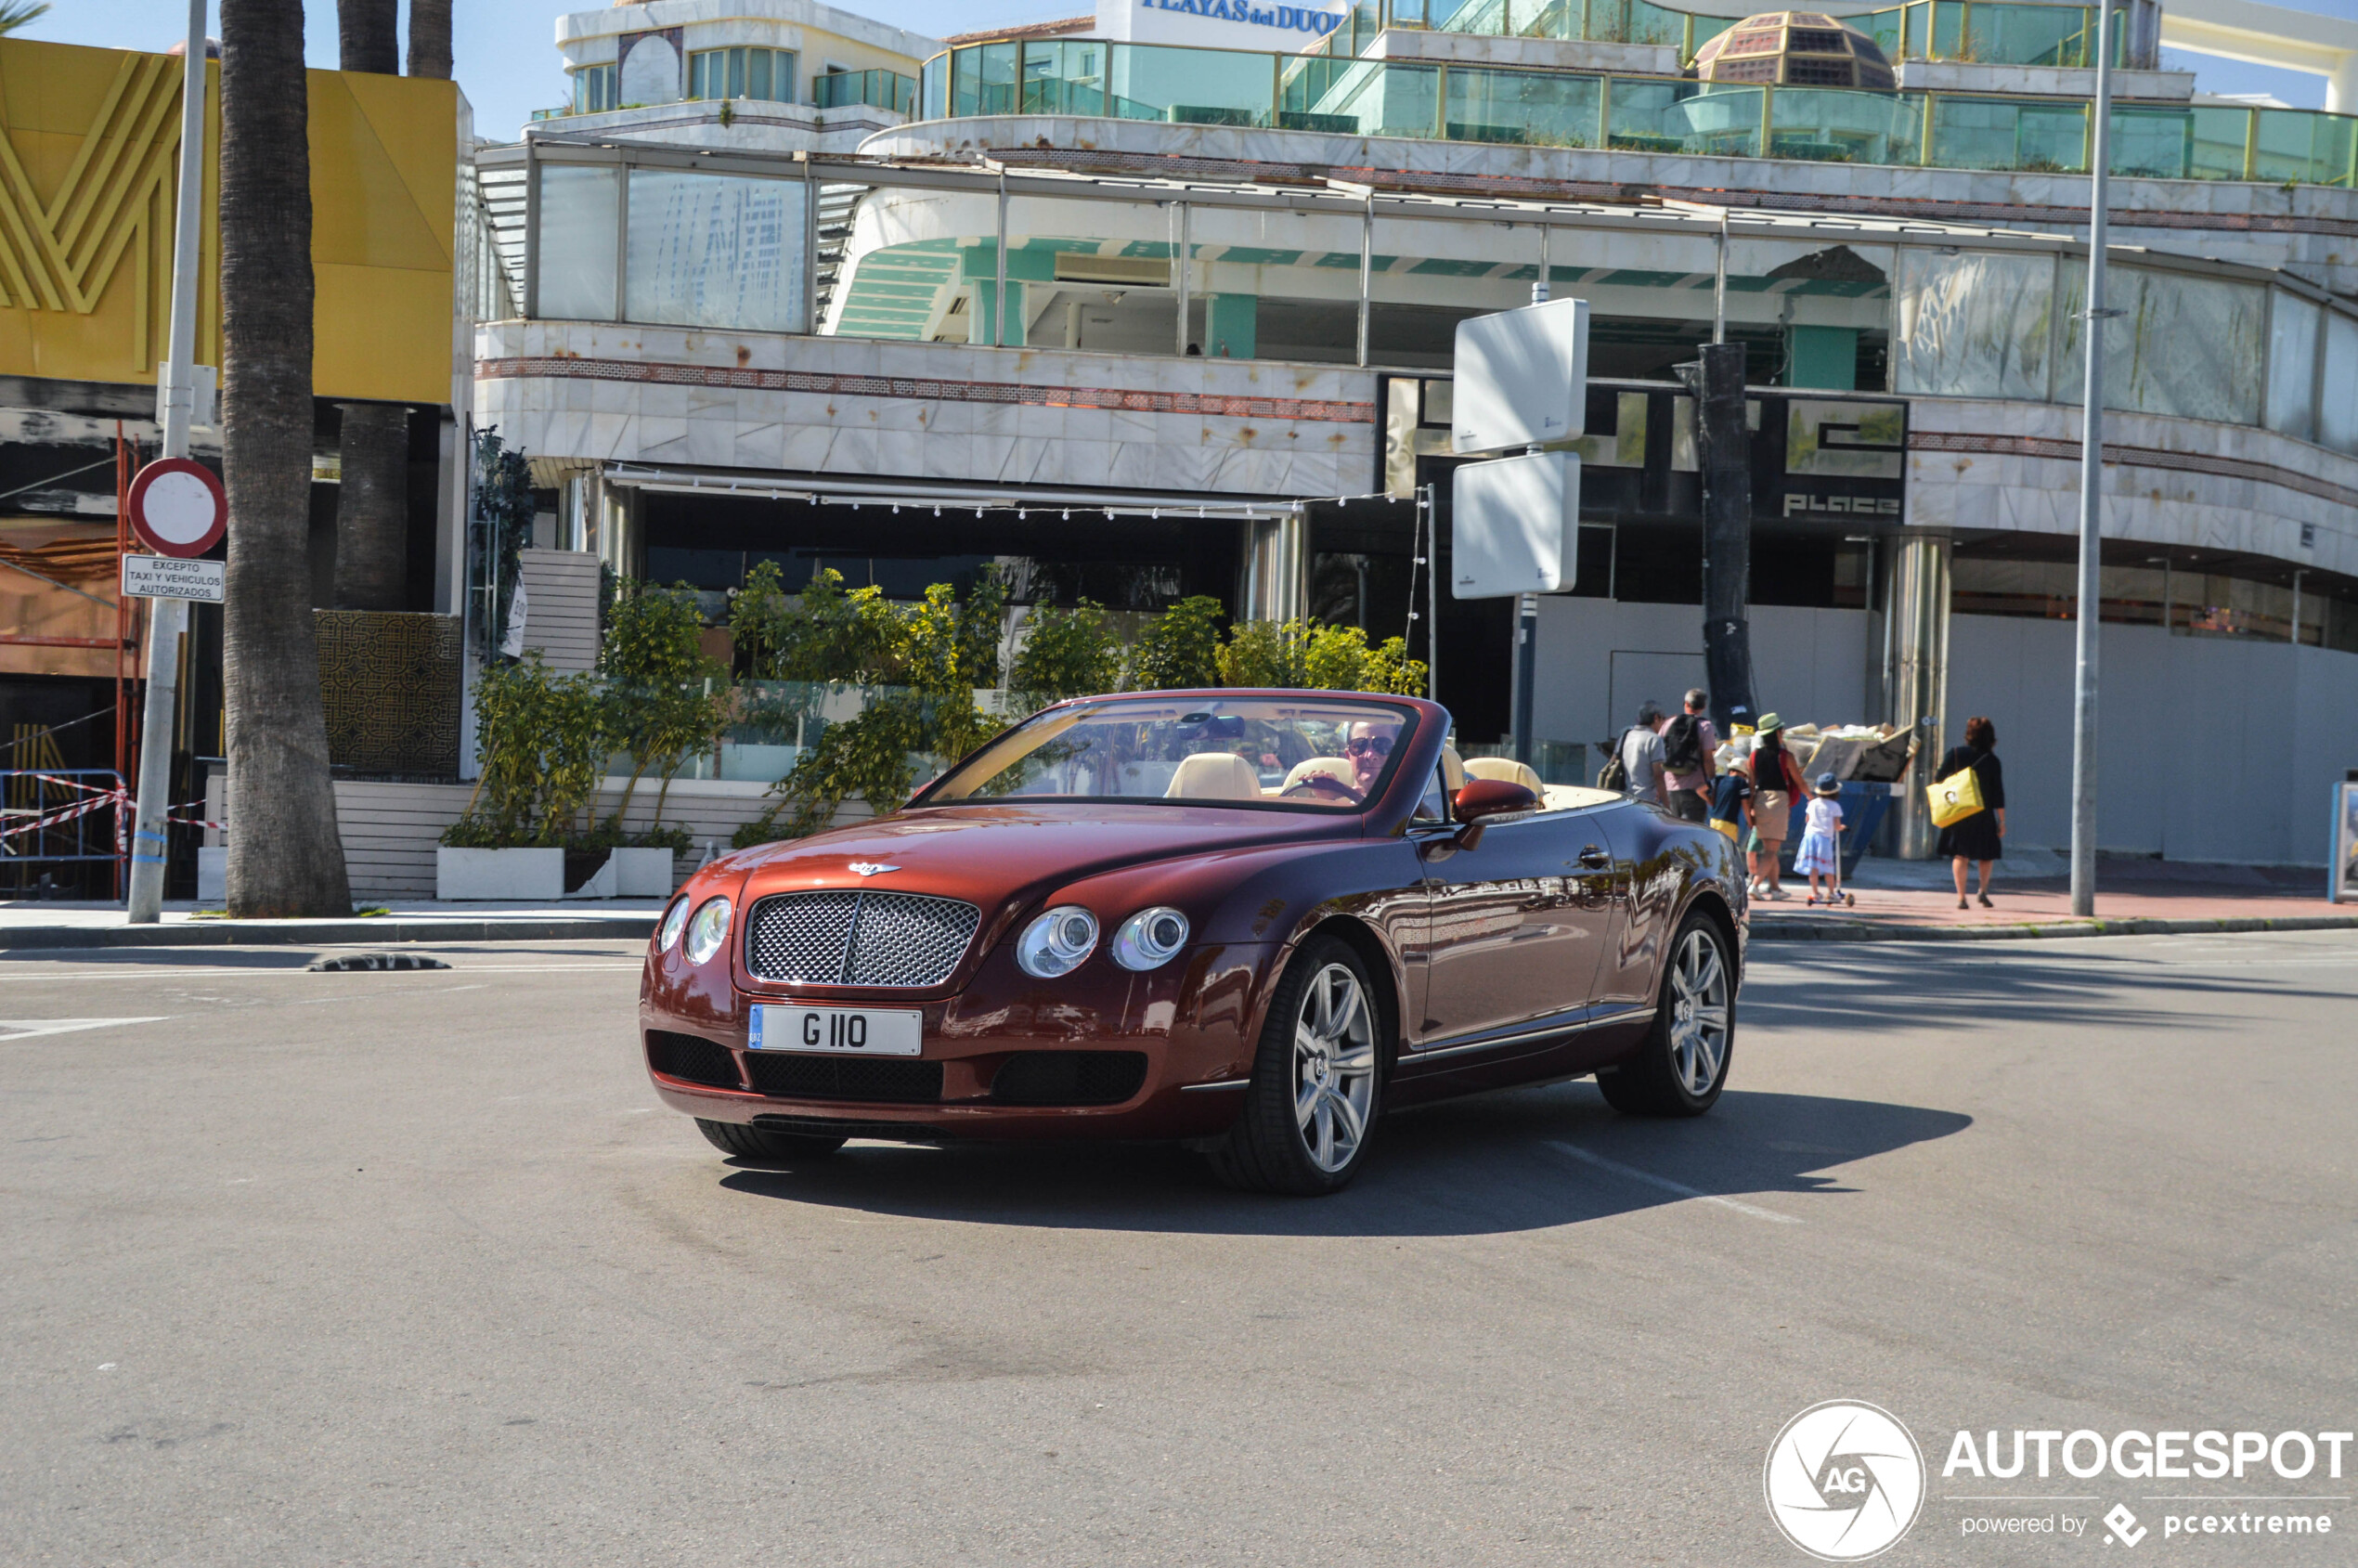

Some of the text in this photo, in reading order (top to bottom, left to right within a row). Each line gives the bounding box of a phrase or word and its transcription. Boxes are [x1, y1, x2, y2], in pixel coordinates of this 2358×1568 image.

[1250, 8, 1275, 27] del
[152, 561, 201, 573] EXCEPTO
[130, 571, 152, 581] TAXI
[164, 575, 221, 587] VEHICULOS
[138, 584, 213, 597] AUTORIZADOS
[803, 1013, 821, 1045] G
